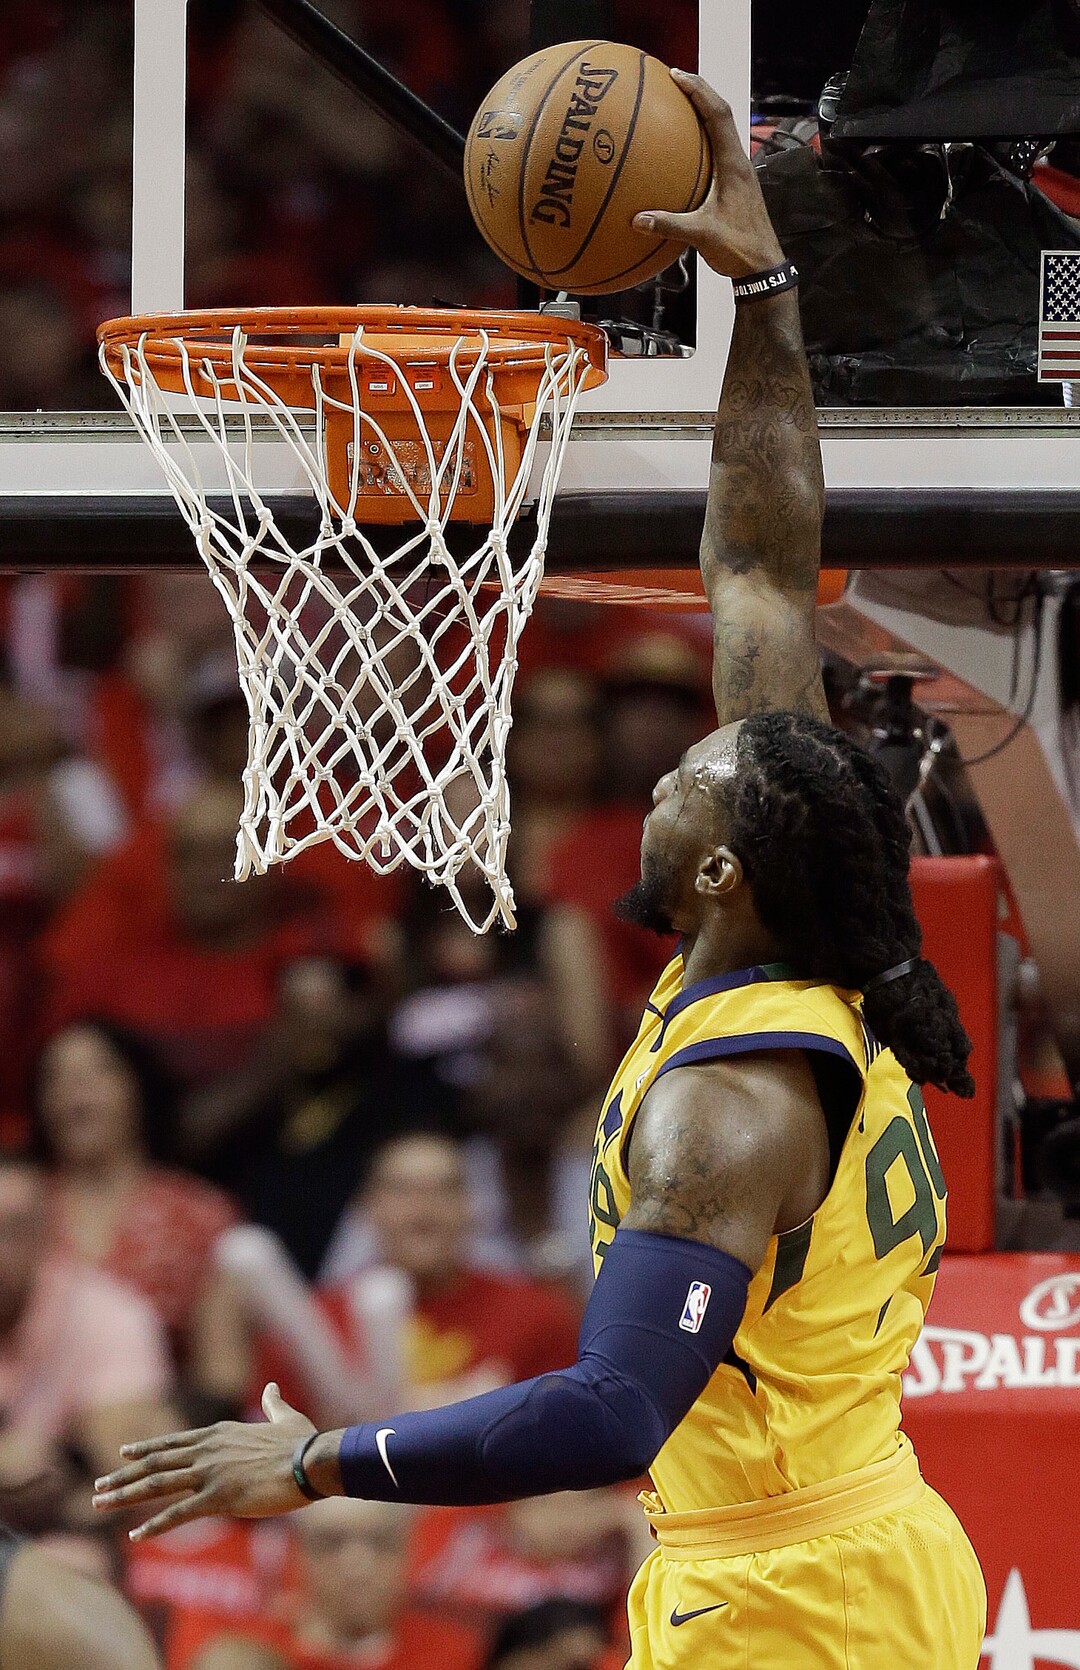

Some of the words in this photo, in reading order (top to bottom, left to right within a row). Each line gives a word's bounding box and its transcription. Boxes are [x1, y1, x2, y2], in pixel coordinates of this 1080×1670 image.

[531, 62, 619, 228] SPALDING
[747, 280, 770, 294] TIME
[769, 272, 787, 287] IT'S
